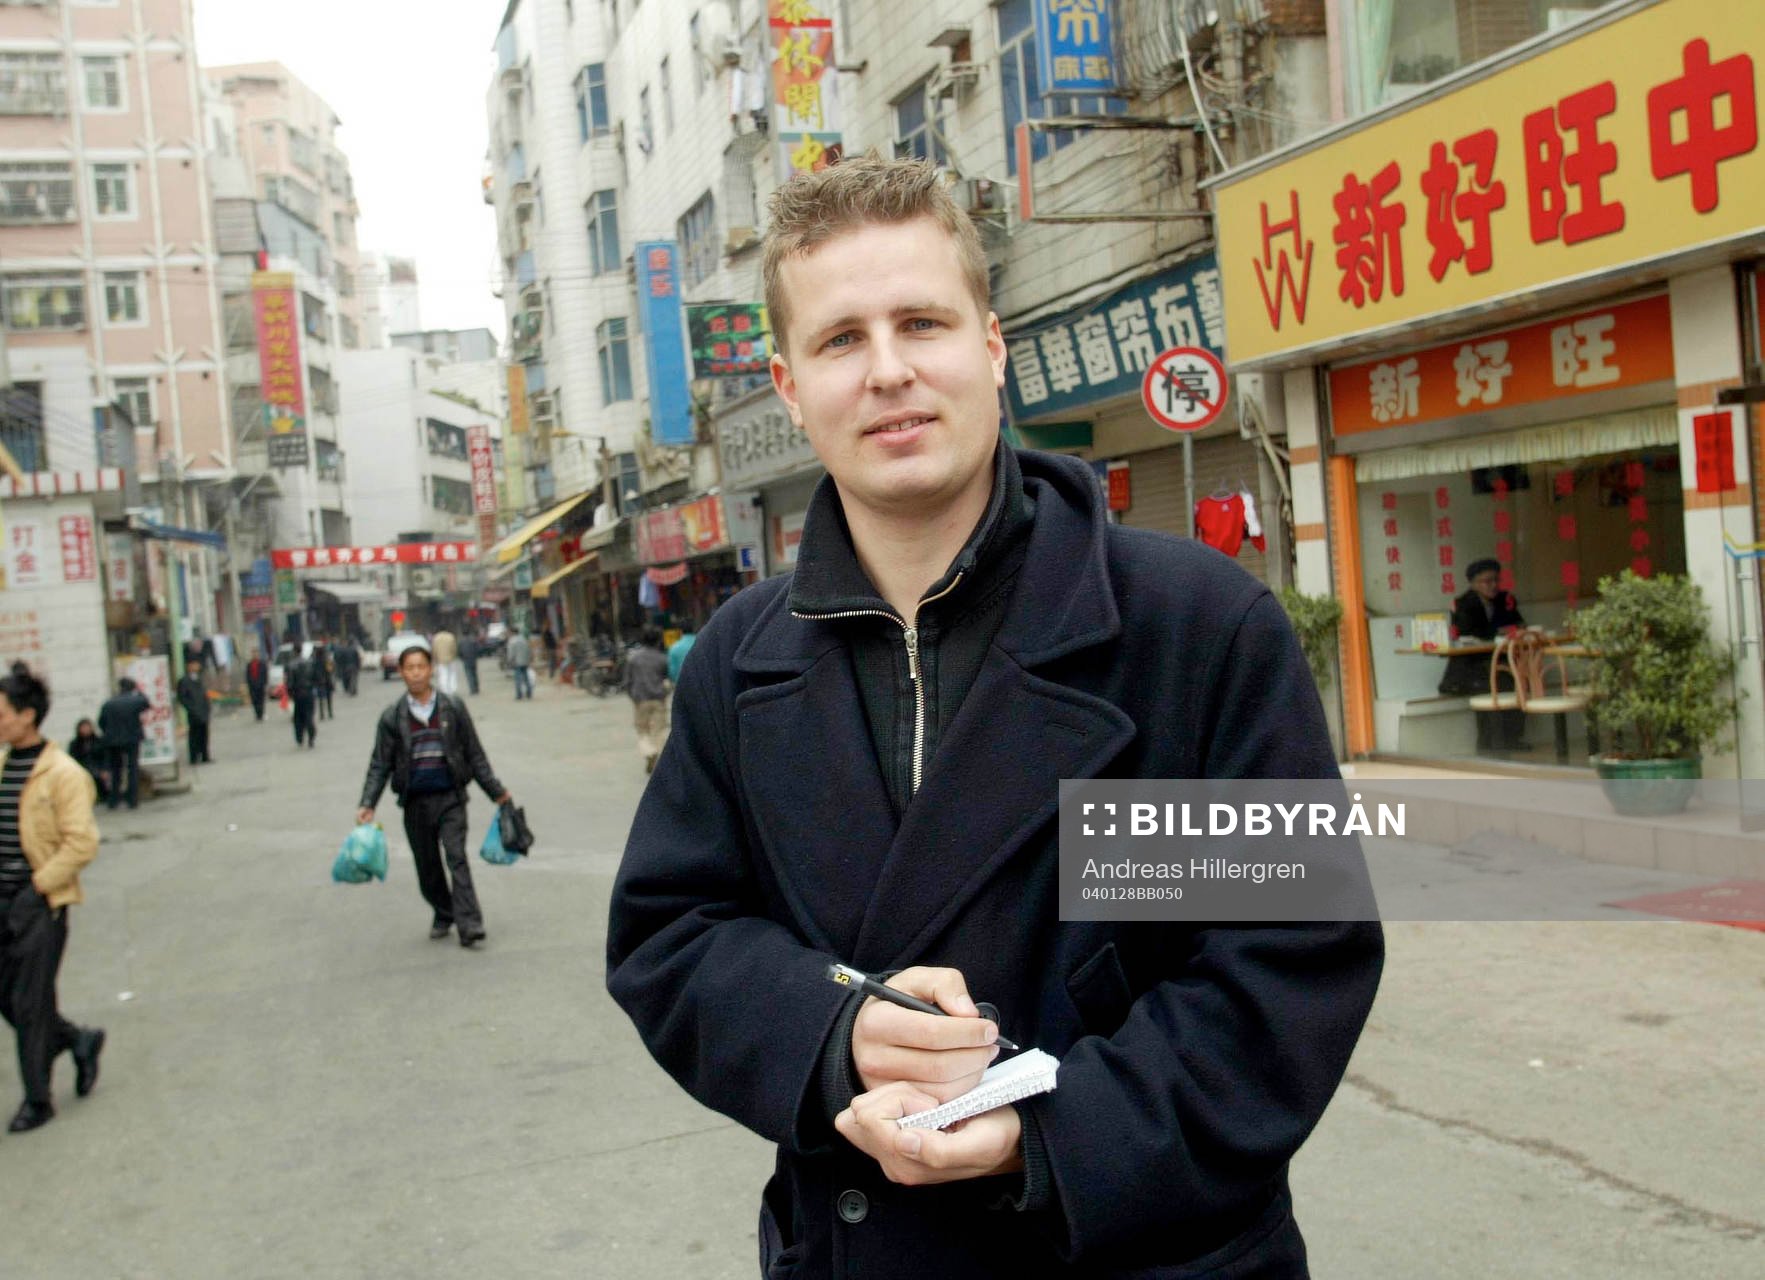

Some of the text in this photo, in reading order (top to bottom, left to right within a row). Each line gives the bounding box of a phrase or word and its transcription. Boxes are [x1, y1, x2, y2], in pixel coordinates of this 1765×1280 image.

[1333, 38, 1758, 308] 新好旺中
[1161, 364, 1209, 414] 停
[1369, 314, 1621, 423] 新好旺
